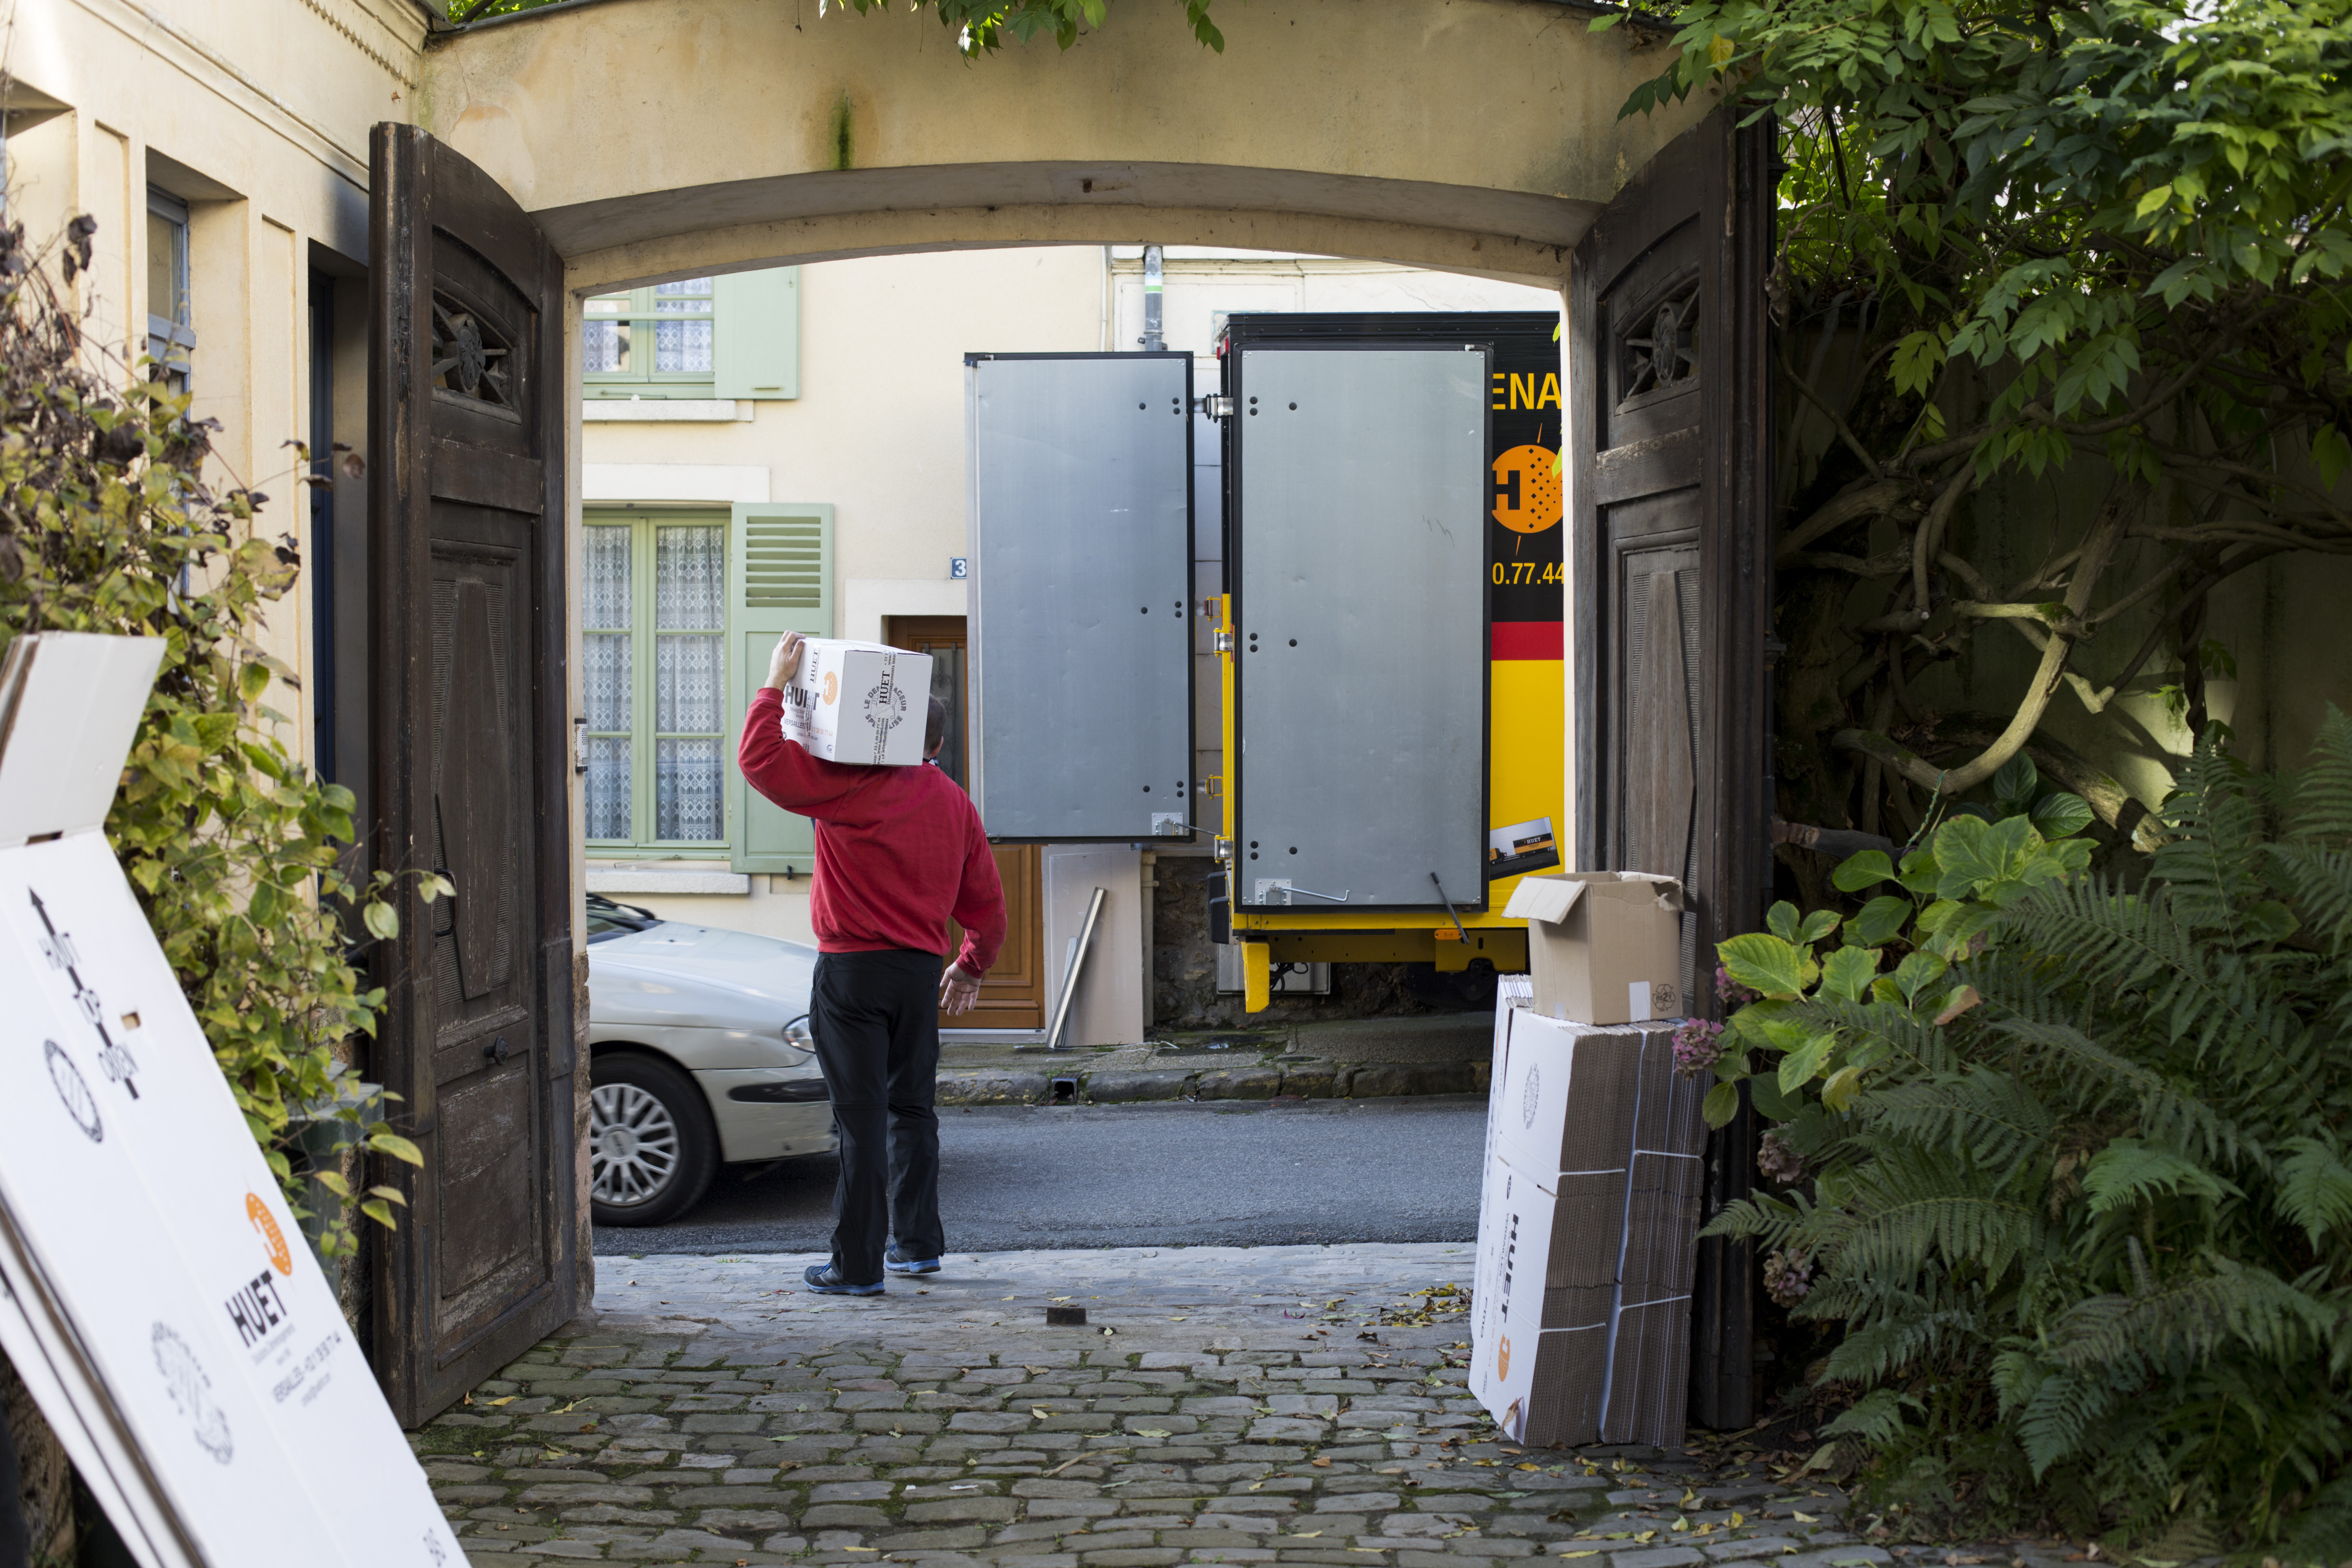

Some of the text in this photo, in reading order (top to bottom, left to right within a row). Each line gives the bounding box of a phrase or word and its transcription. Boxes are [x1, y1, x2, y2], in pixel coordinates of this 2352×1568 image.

[955, 560, 967, 576] 3
[864, 699, 871, 709] LE
[879, 670, 890, 704] HUET
[784, 719, 804, 729] VERSAILLES
[1499, 1213, 1509, 1276] VERSAILLES
[1502, 1214, 1519, 1323] HUET
[225, 1269, 287, 1348] HUET
